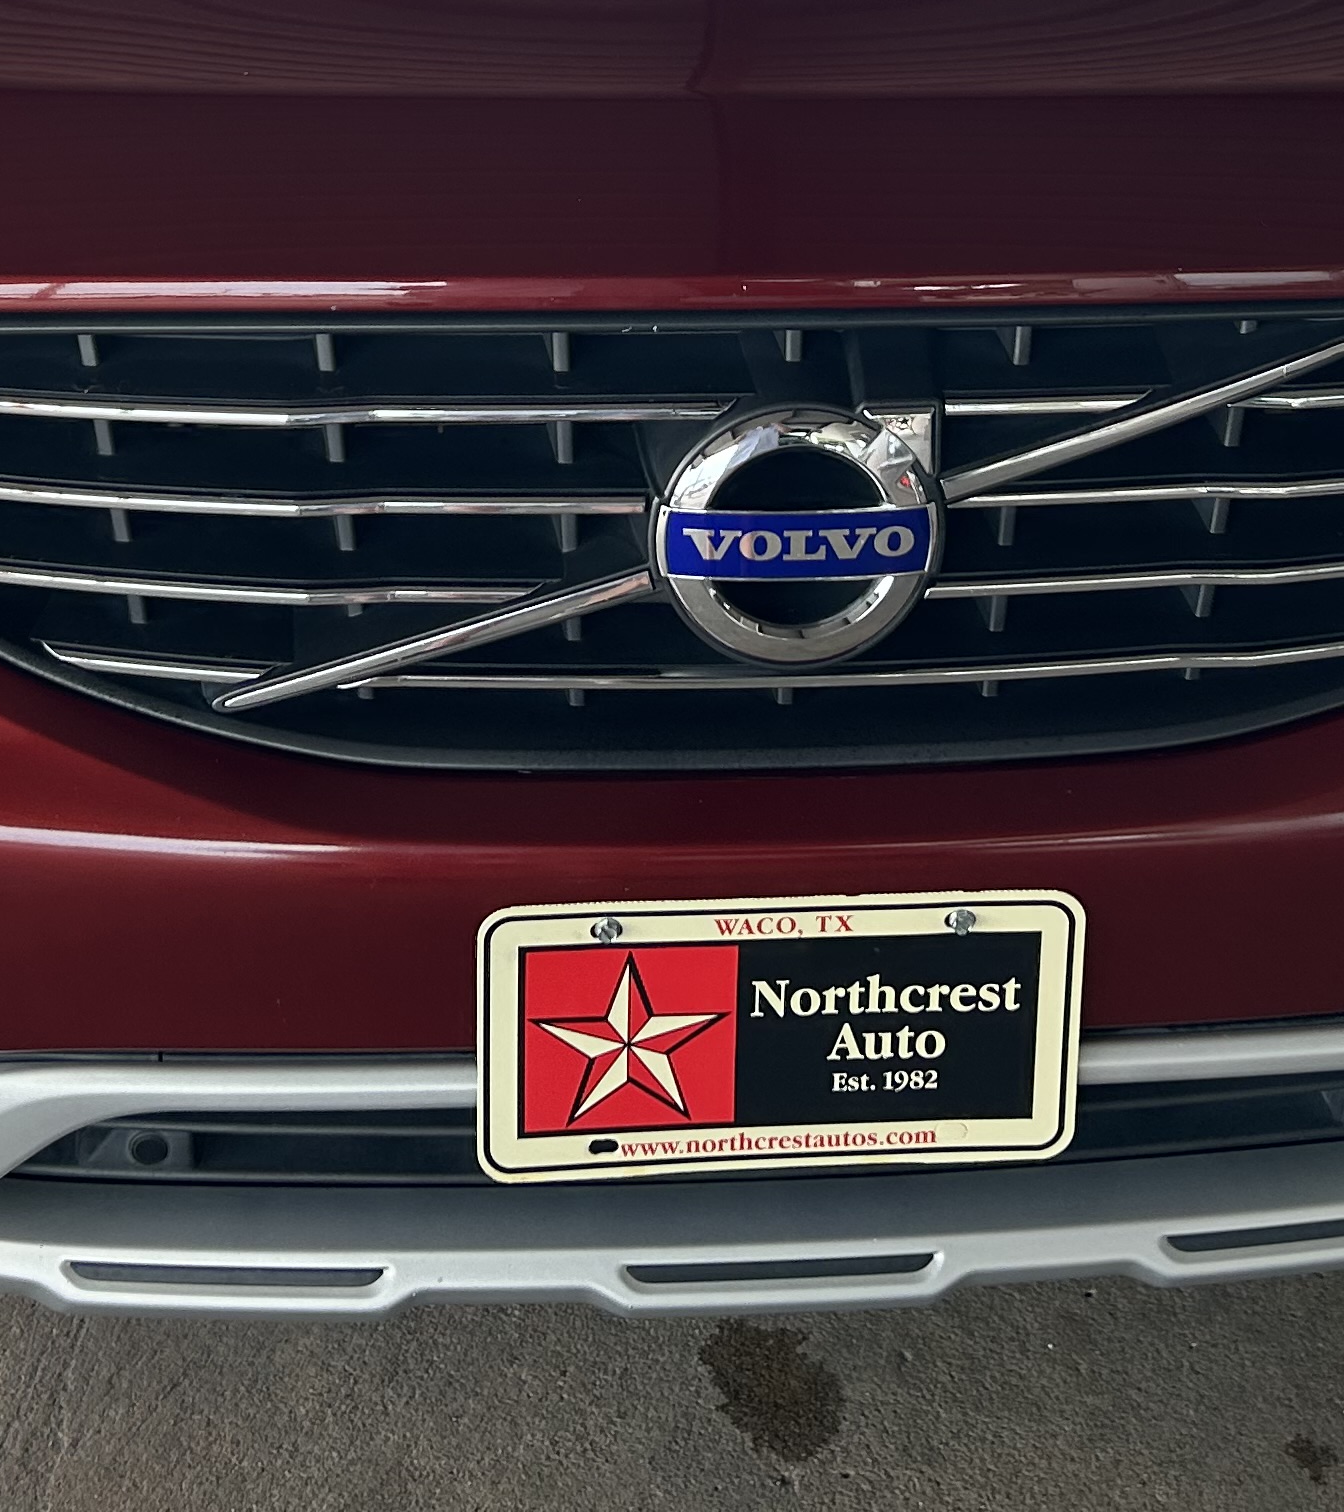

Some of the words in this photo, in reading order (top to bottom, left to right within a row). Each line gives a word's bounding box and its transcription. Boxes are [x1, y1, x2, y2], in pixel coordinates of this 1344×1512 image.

[682, 525, 915, 561] VOLVO
[714, 916, 804, 938] WACO,
[816, 914, 854, 933] TX
[750, 973, 1022, 1018] Northcrest
[826, 1022, 946, 1061] Auto
[831, 1072, 876, 1092] Est.
[882, 1069, 938, 1093] 1982
[620, 1129, 938, 1158] www.northcrestautos.com
